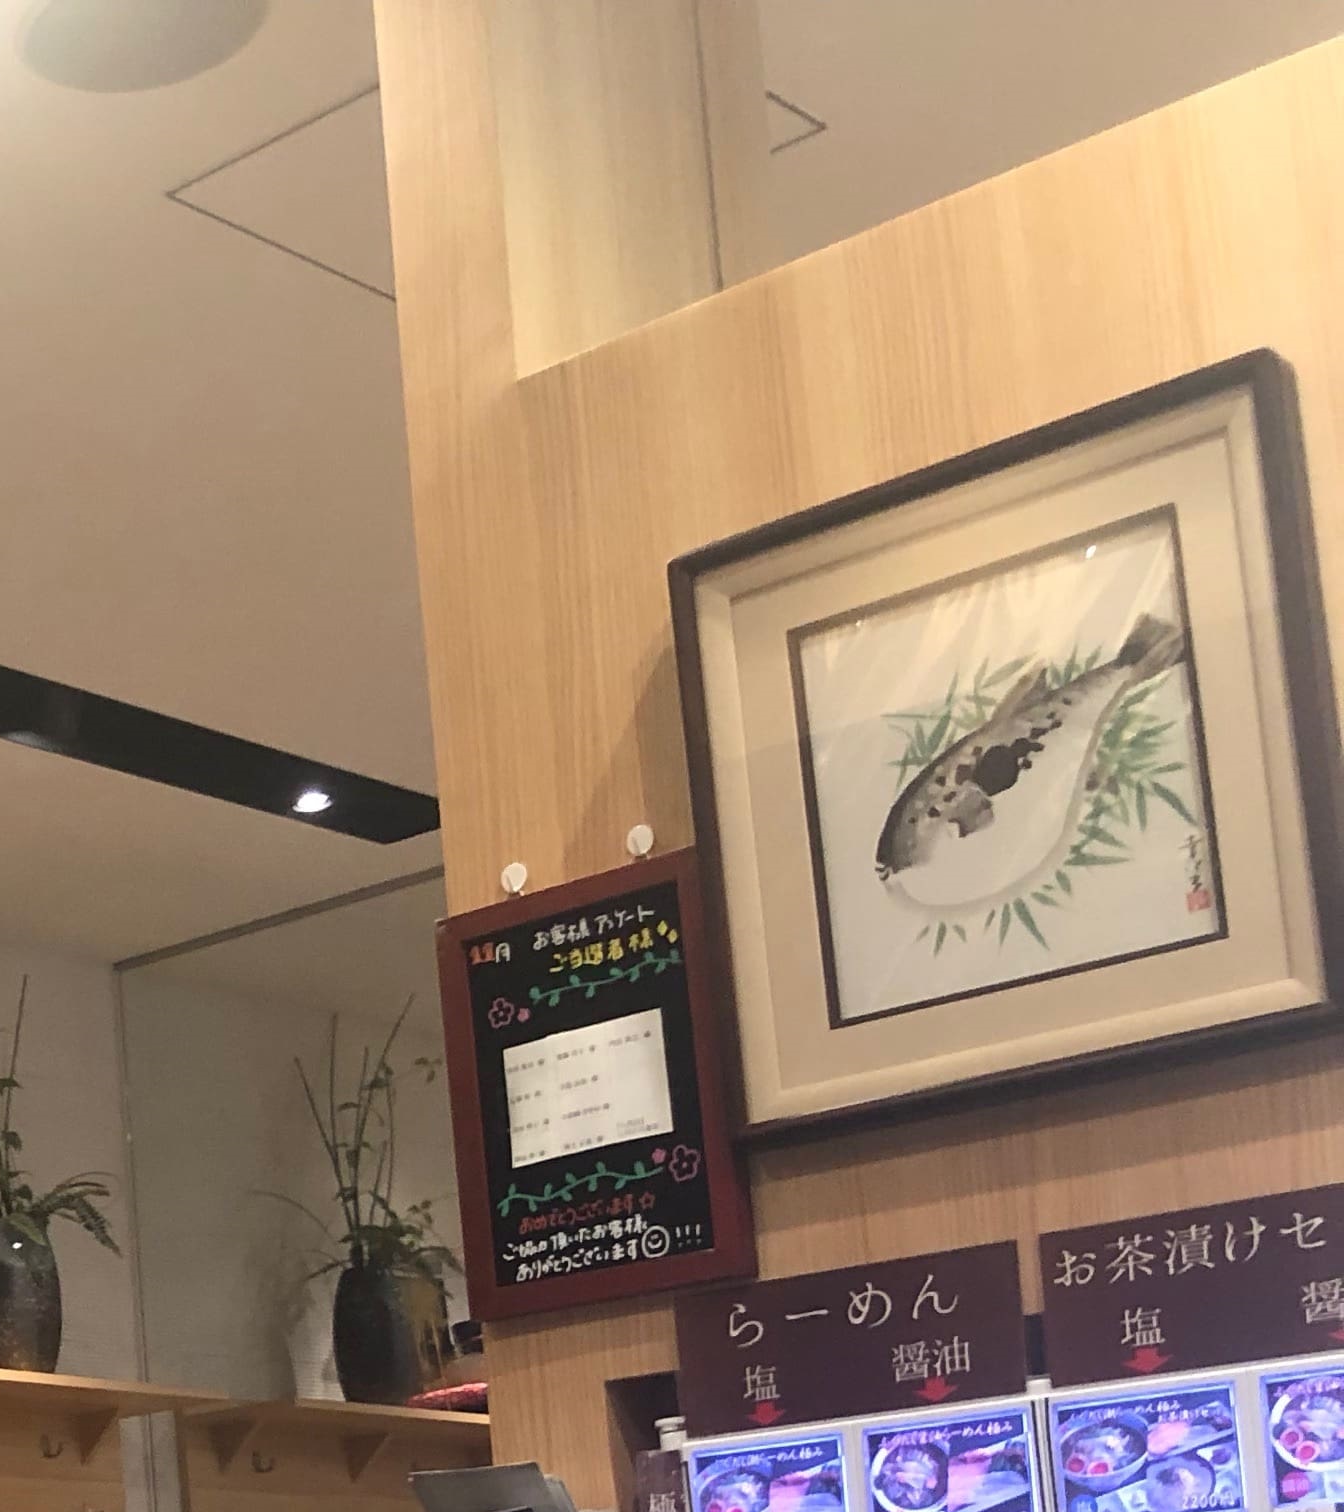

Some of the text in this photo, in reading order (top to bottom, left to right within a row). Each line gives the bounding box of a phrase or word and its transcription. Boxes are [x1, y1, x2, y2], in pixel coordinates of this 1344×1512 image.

[1054, 1212, 1326, 1288] お茶漬けセ
[727, 1273, 960, 1348] らーめん
[1121, 1308, 1166, 1346] 塩
[743, 1338, 972, 1401] 塩 醤油
